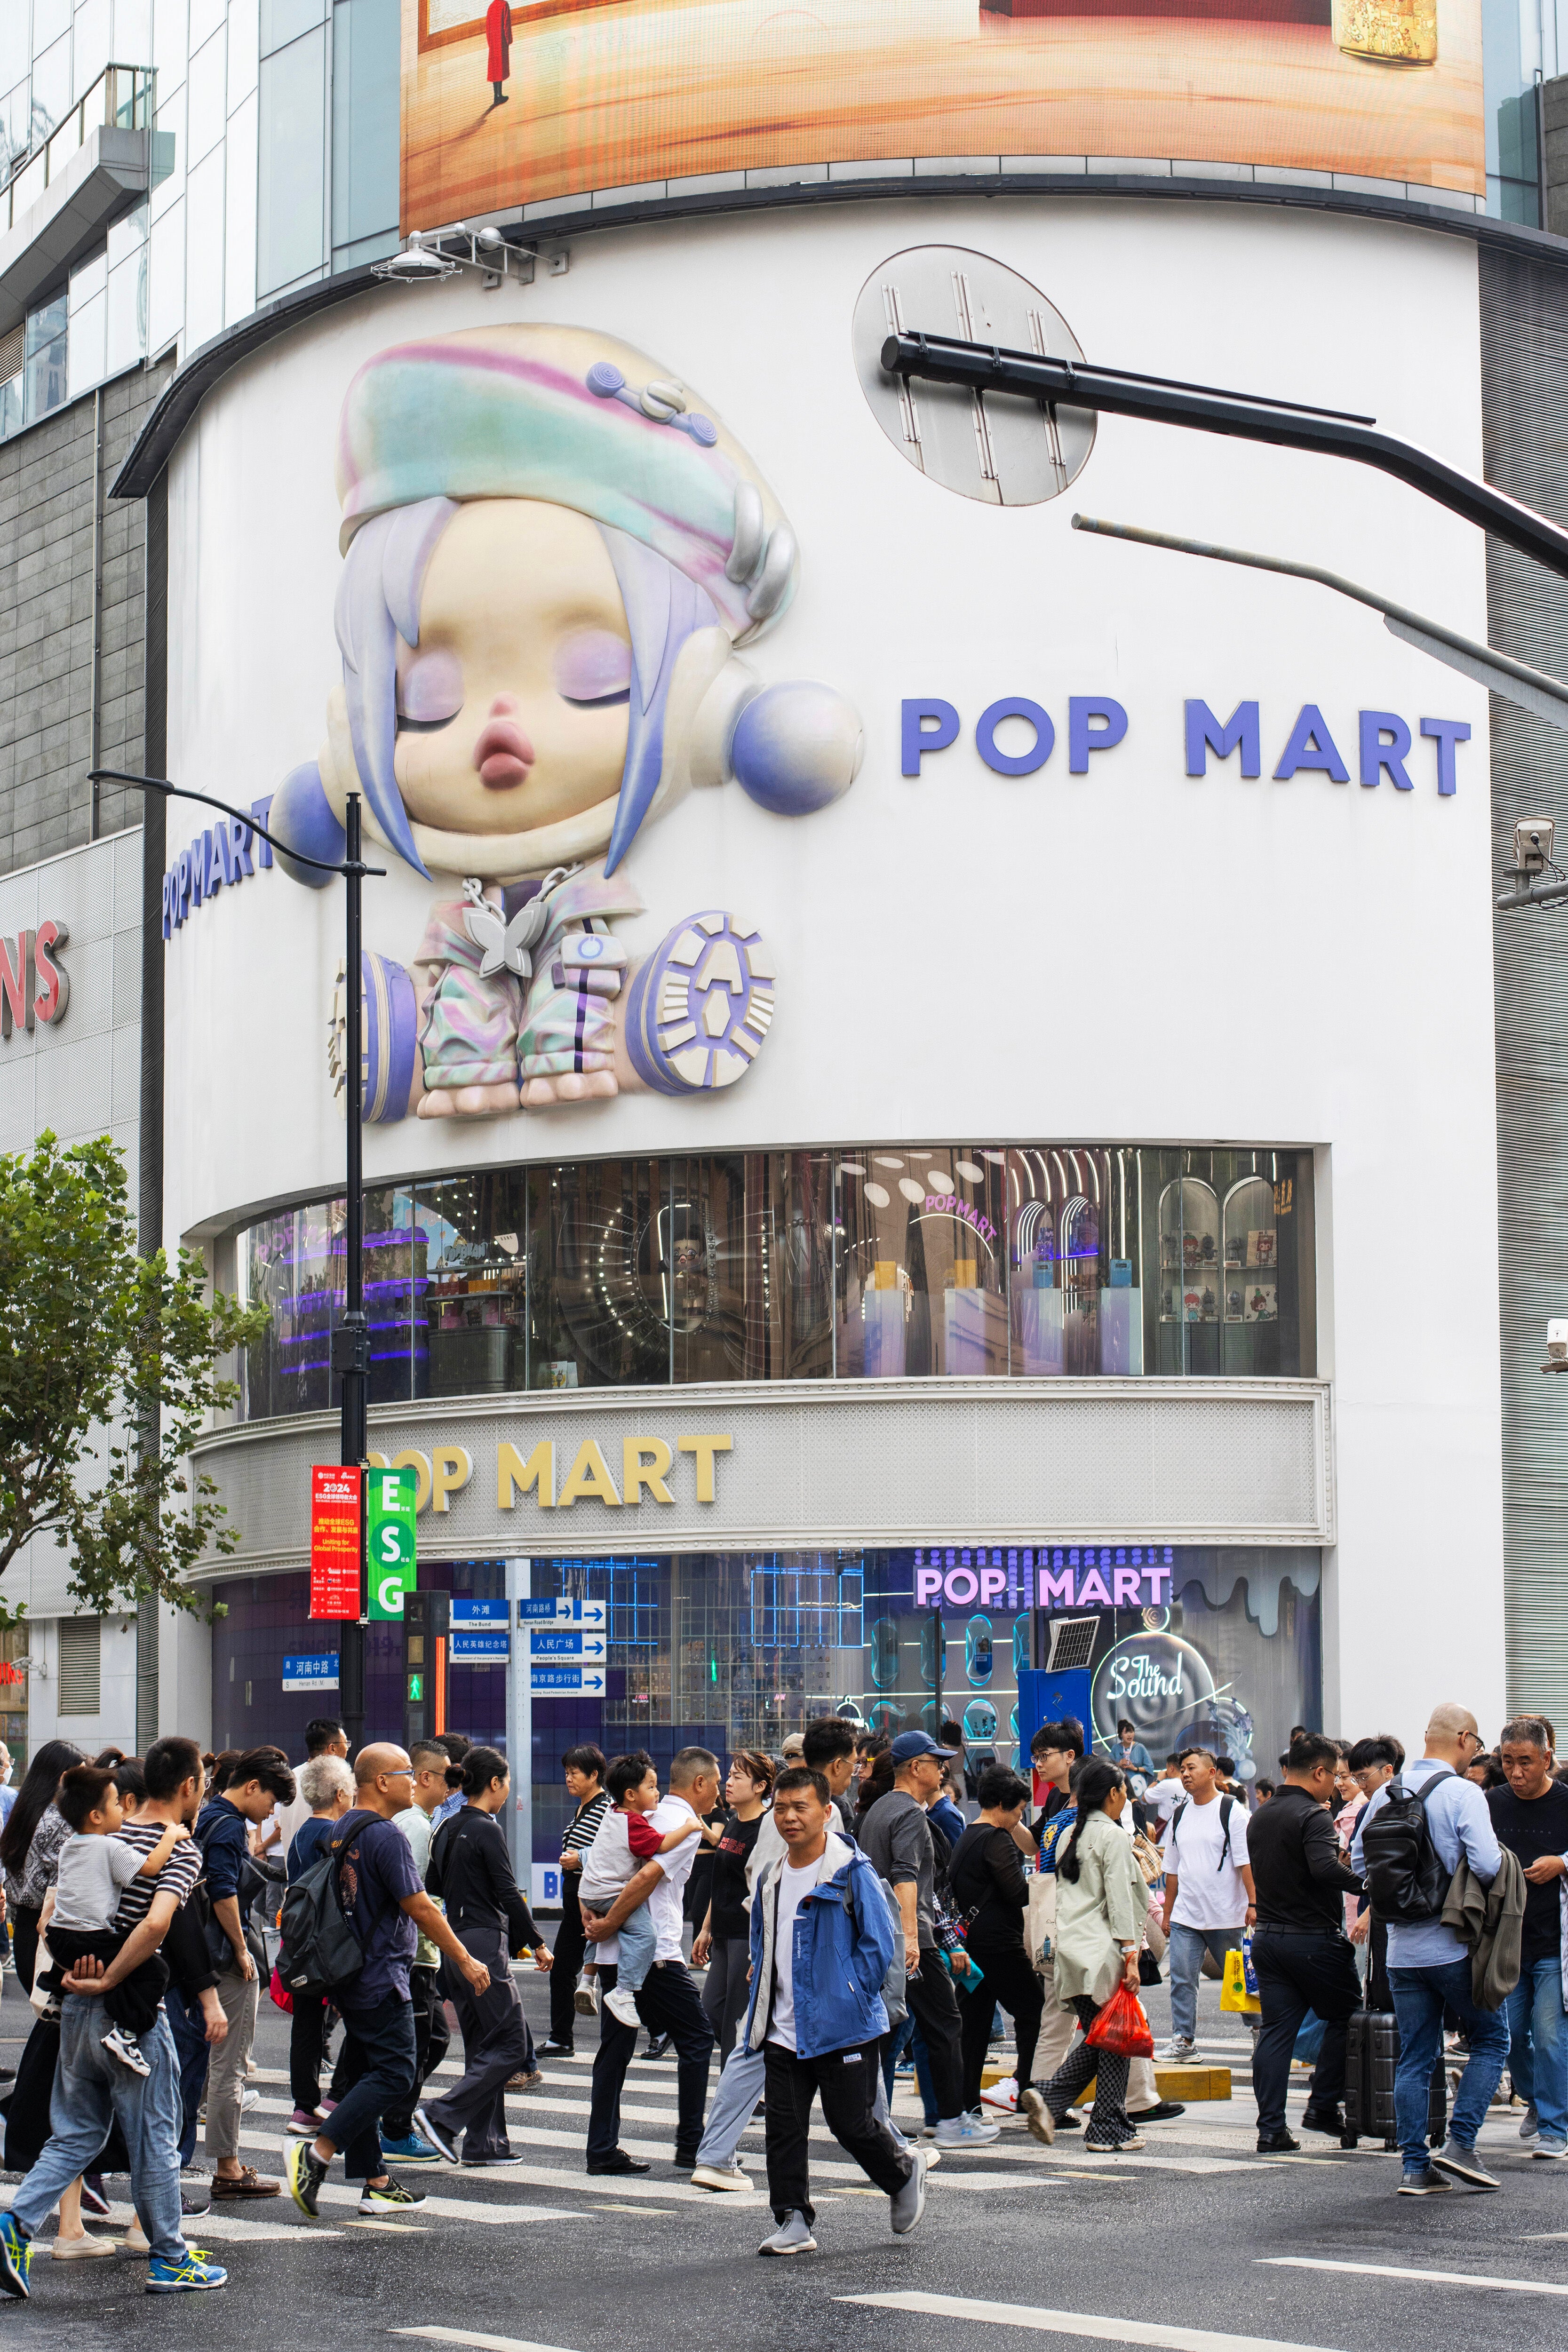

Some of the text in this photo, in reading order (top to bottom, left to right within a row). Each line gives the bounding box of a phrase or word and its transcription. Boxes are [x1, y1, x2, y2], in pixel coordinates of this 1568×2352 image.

[901, 696, 1471, 795] POP MART
[162, 794, 274, 940] POP MART
[925, 1194, 997, 1242] POP MART
[366, 1435, 734, 1515] OP MART
[323, 1483, 350, 1493] 2024
[318, 1518, 355, 1526] 推动全球ESG
[917, 1567, 1171, 1606] POP MART
[472, 1605, 490, 1615] 外滩
[526, 1603, 551, 1614] 河南路桥
[455, 1640, 508, 1649] 人民英雄纪念塔
[537, 1639, 574, 1649] 人民广场
[285, 1658, 339, 1675] 南 河南中路 北
[1131, 1655, 1161, 1683] The
[531, 1674, 580, 1684] 南京路步行街
[1106, 1652, 1184, 1700] Sound
